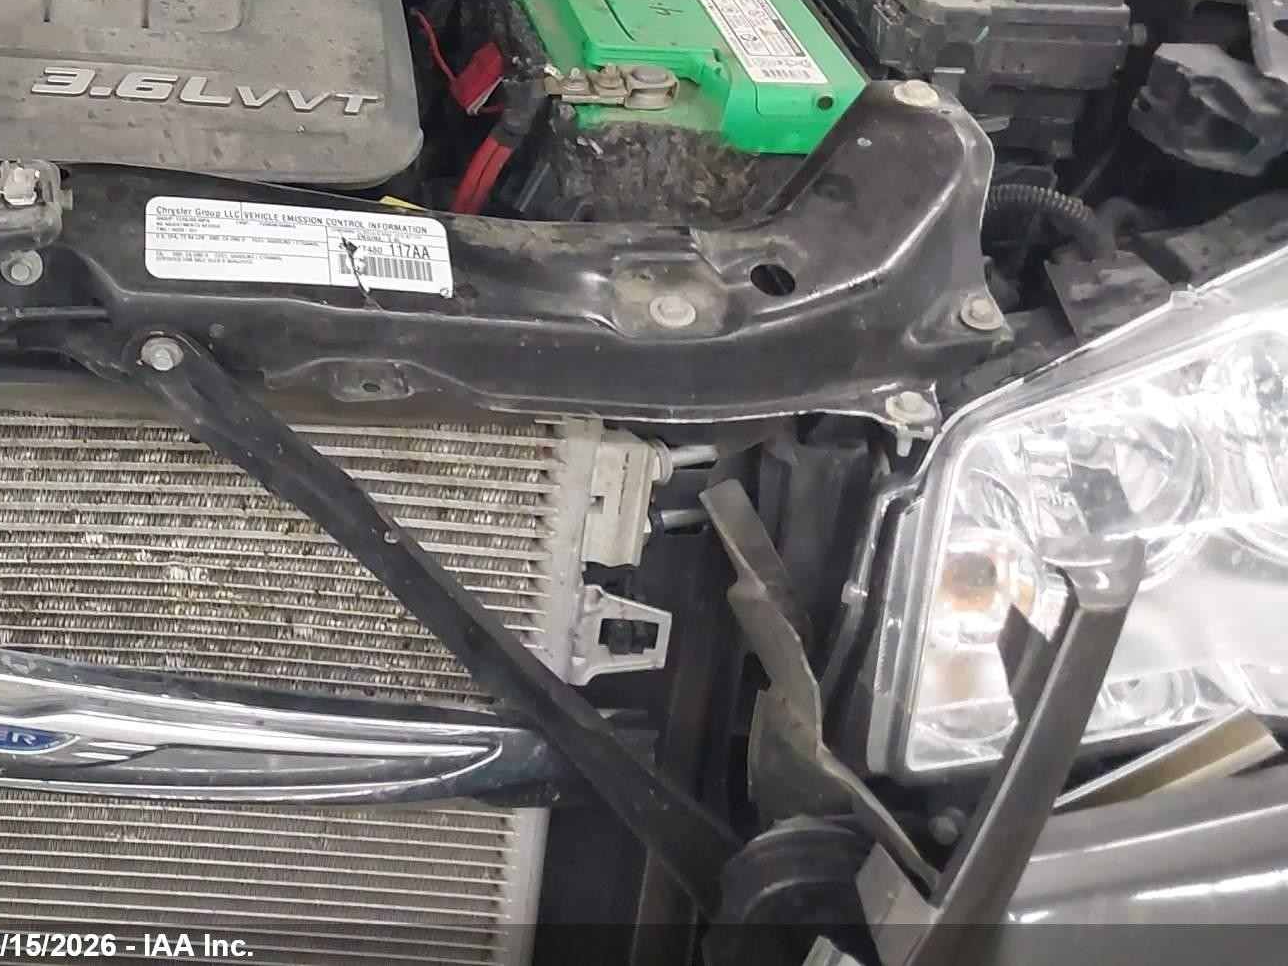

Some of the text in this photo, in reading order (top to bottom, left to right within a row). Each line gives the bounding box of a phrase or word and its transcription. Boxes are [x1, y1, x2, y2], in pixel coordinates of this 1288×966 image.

[156, 205, 240, 219] Chrysler Group LLC
[244, 211, 279, 222] VEHICLE
[282, 214, 323, 225] EMISSION
[325, 217, 364, 229] CONTROL
[367, 221, 428, 234] INFORMATION
[390, 242, 432, 260] 117AA
